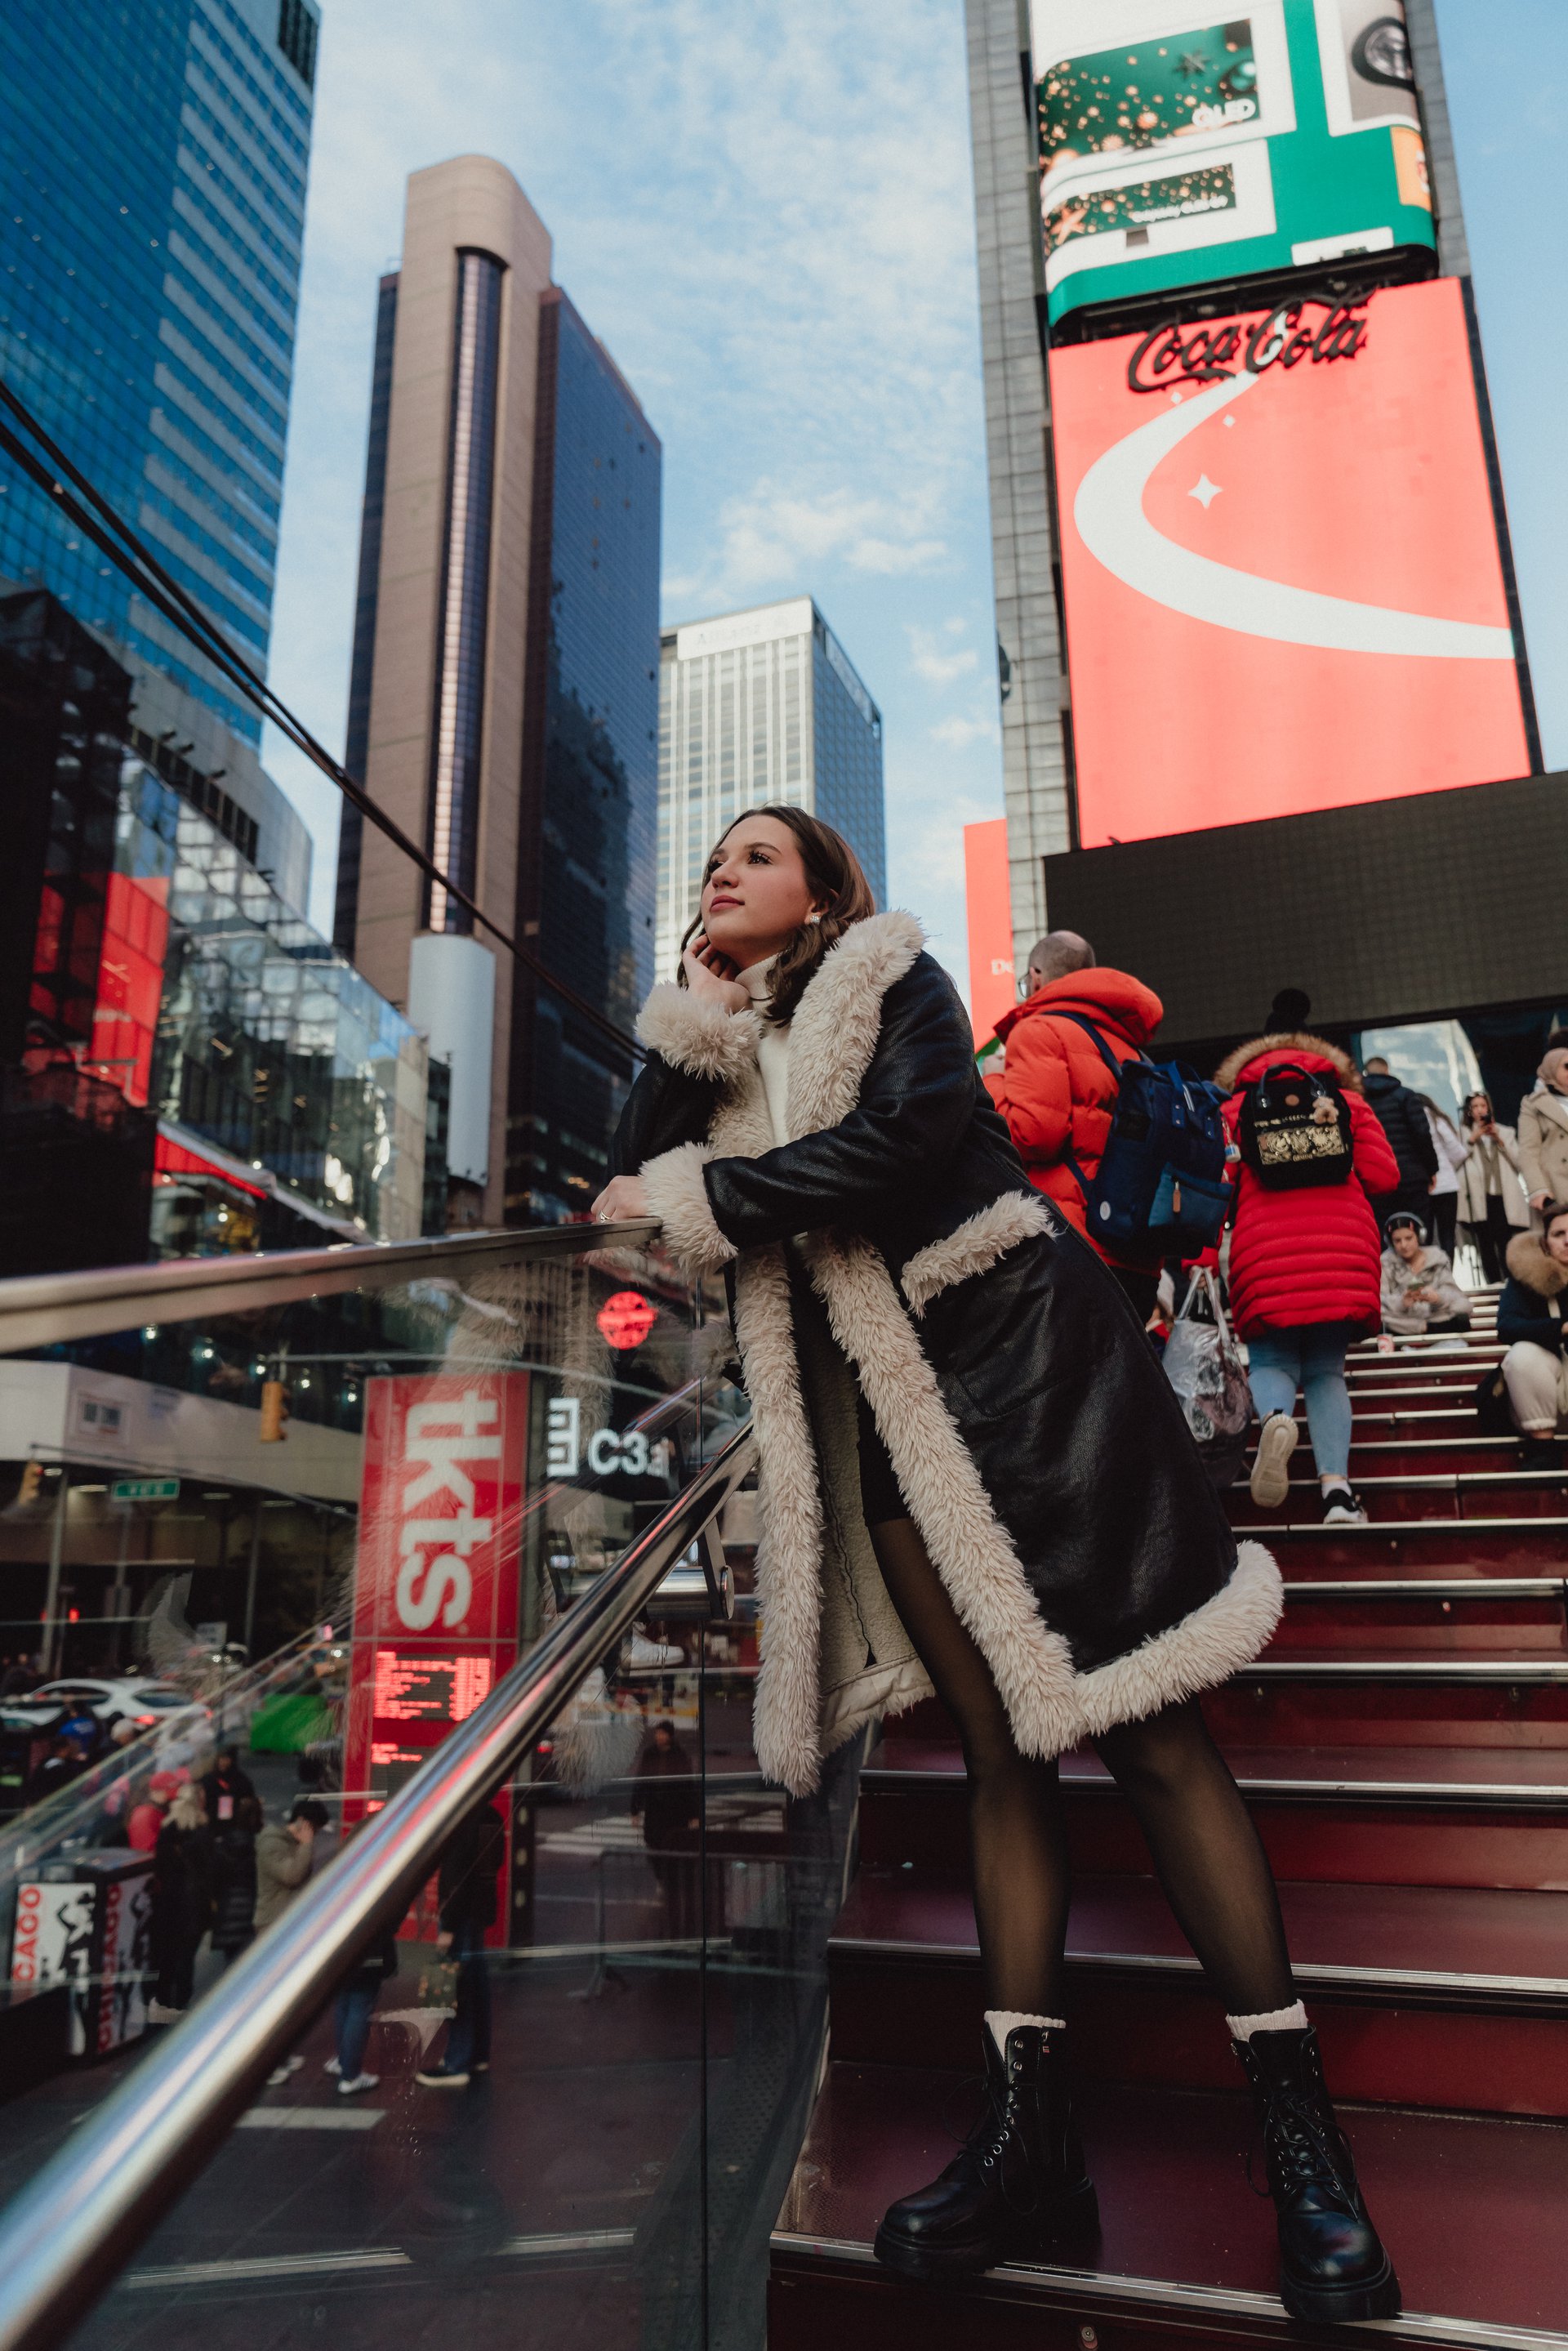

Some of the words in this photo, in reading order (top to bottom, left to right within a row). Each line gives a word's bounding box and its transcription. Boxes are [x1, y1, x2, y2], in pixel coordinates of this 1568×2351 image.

[1128, 288, 1377, 393] Coca-Cola
[396, 1389, 502, 1631] tkts
[11, 1887, 42, 1983] CAGO
